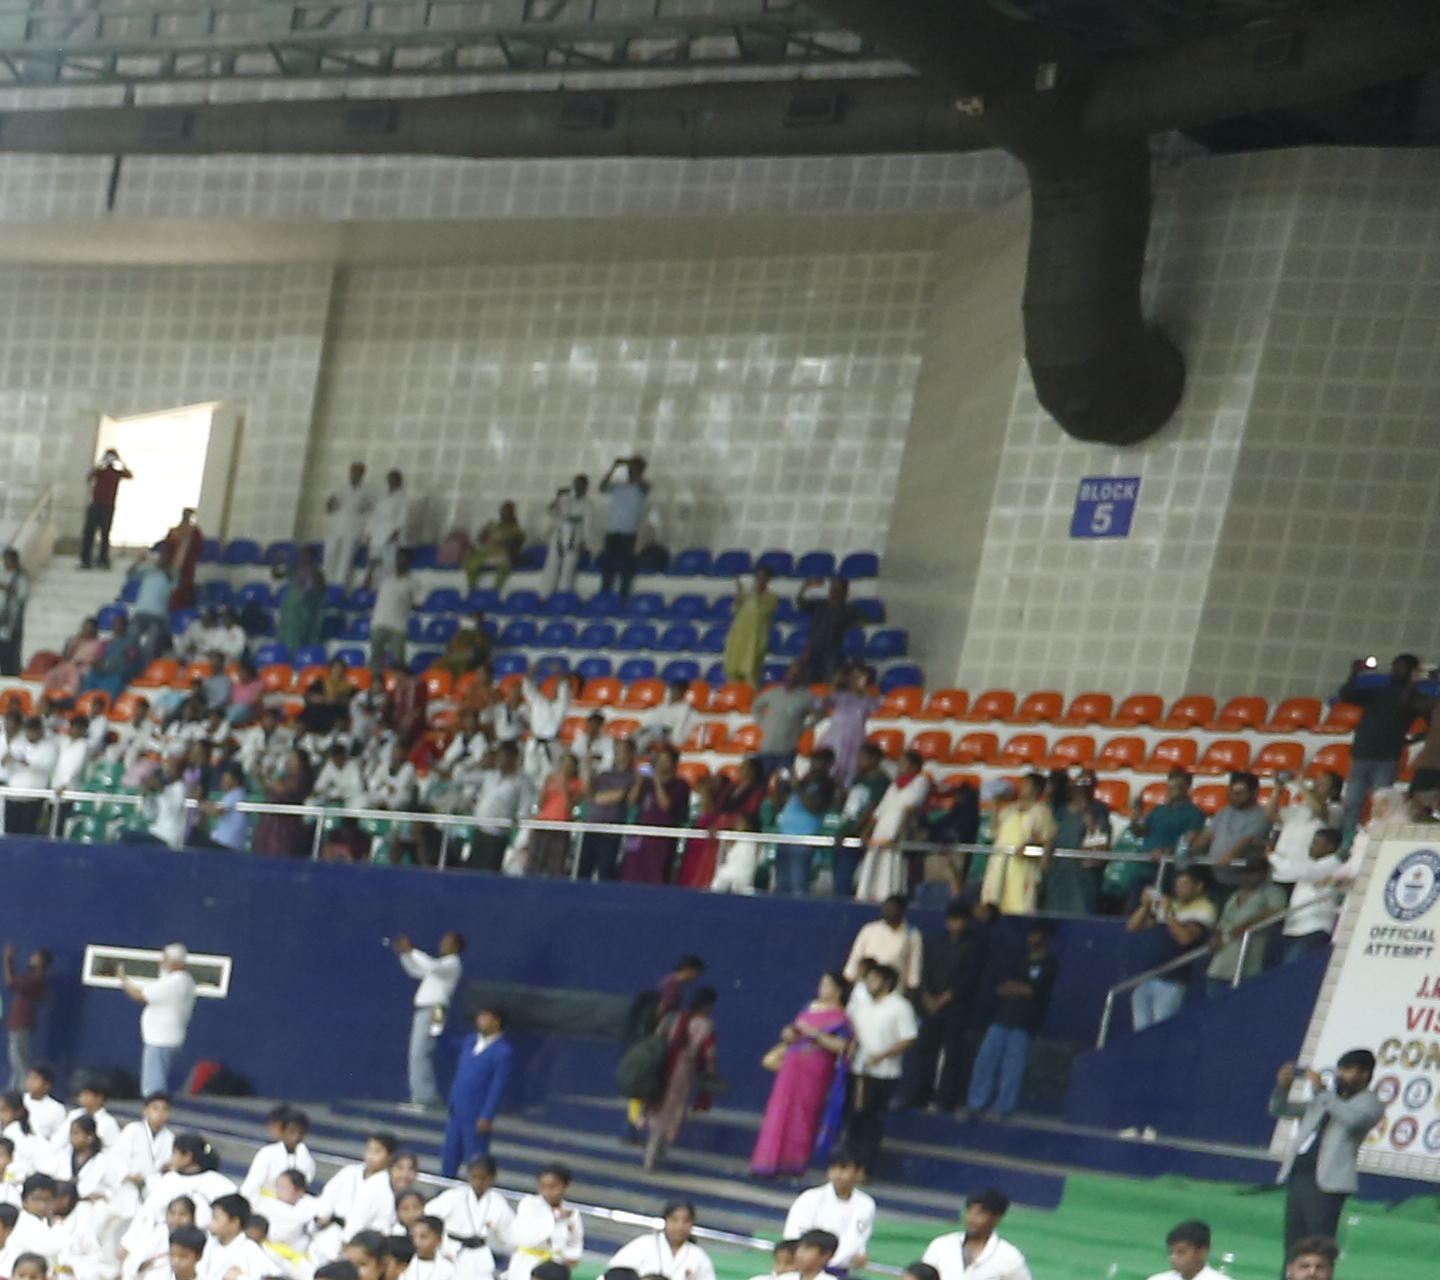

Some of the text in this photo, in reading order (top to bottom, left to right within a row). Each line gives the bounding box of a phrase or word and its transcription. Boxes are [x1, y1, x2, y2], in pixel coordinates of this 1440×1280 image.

[1080, 482, 1135, 500] BLOCK
[1090, 502, 1114, 533] 5
[1368, 927, 1436, 941] OFFICIAL
[1362, 943, 1435, 958] ATTEMPT
